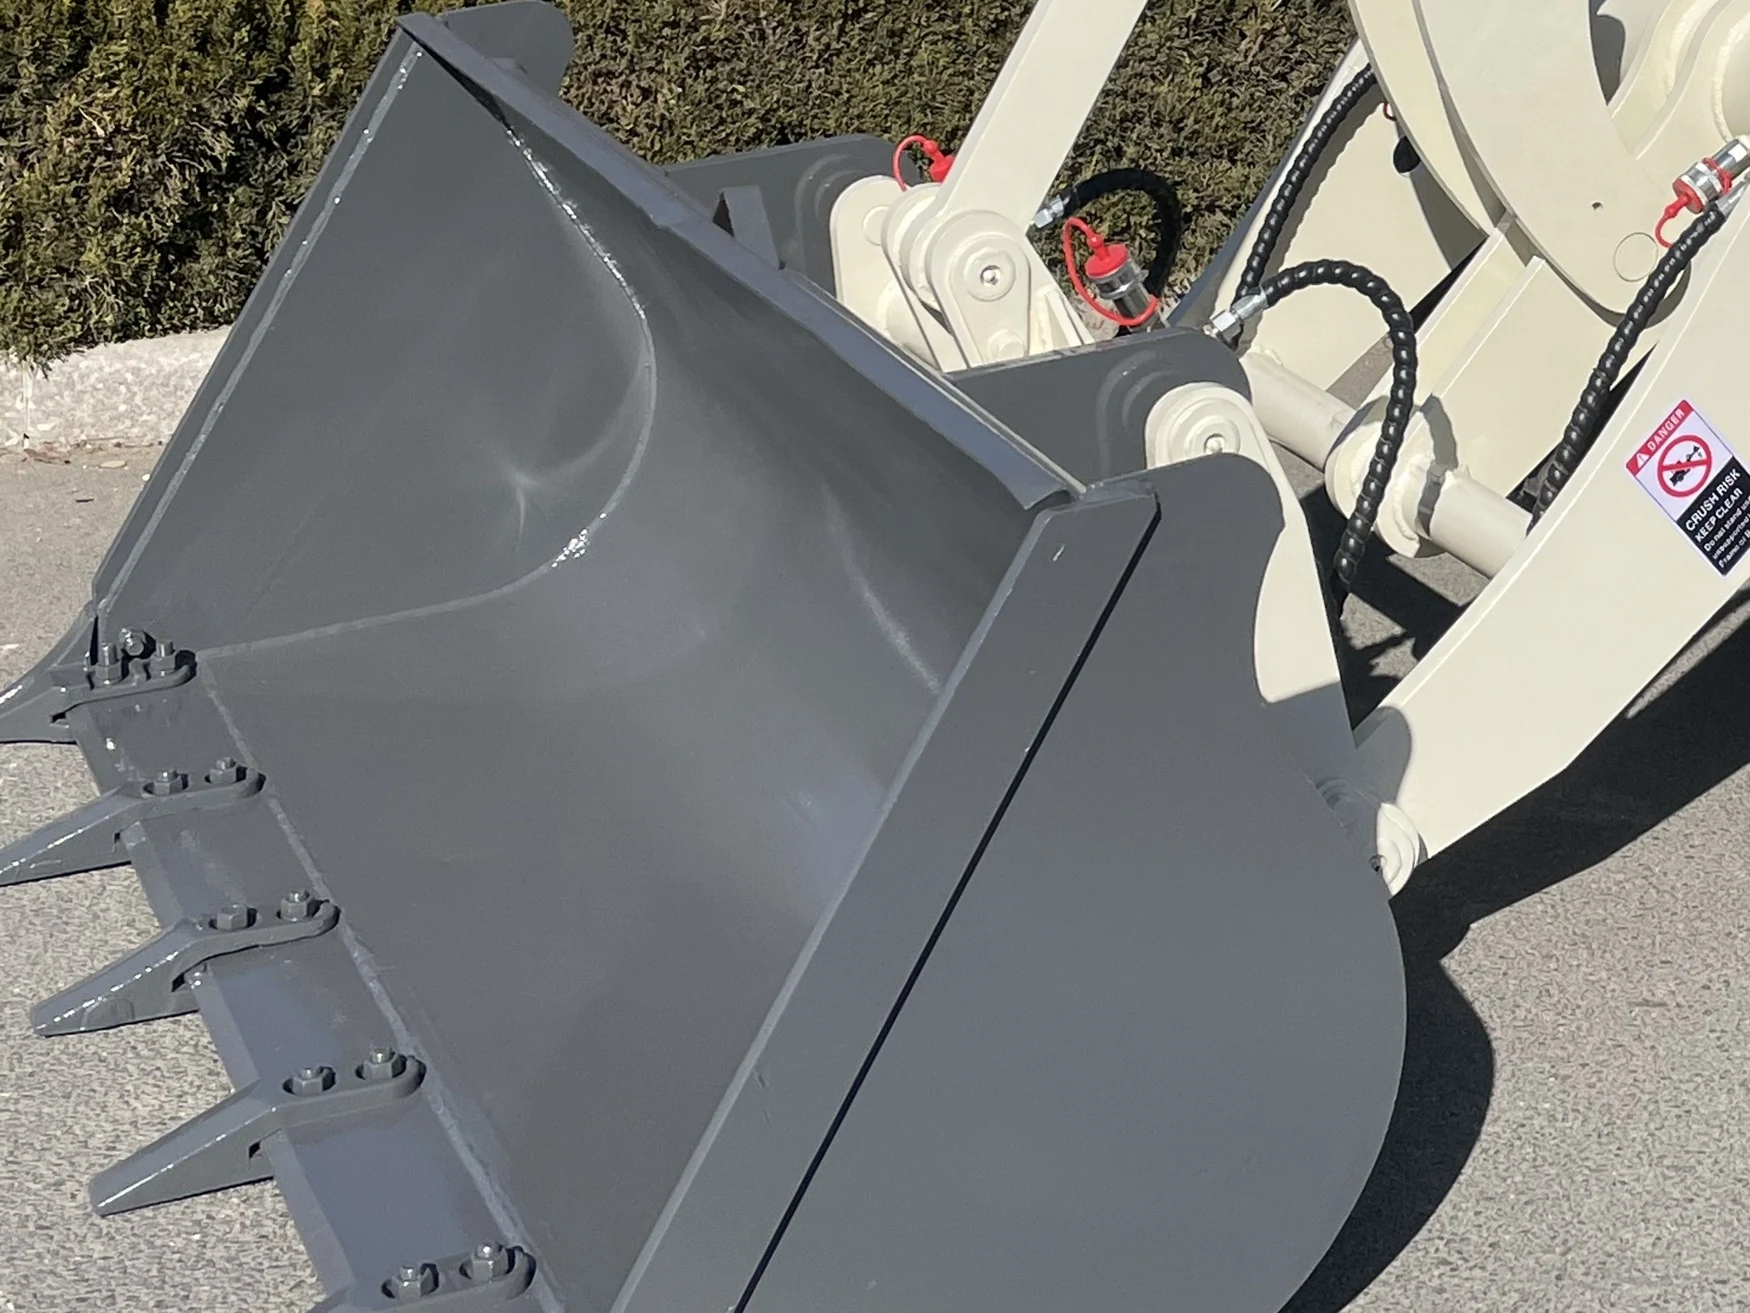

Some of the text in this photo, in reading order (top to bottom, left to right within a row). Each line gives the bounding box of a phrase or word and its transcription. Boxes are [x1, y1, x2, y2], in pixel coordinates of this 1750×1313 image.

[1647, 409, 1684, 451] DANGER
[1686, 469, 1740, 530] CRUSH RISK
[1695, 488, 1742, 542] KEEP CLEAR
[1704, 539, 1714, 551] Do
[1714, 527, 1725, 541] not
[1725, 508, 1741, 530] stand
